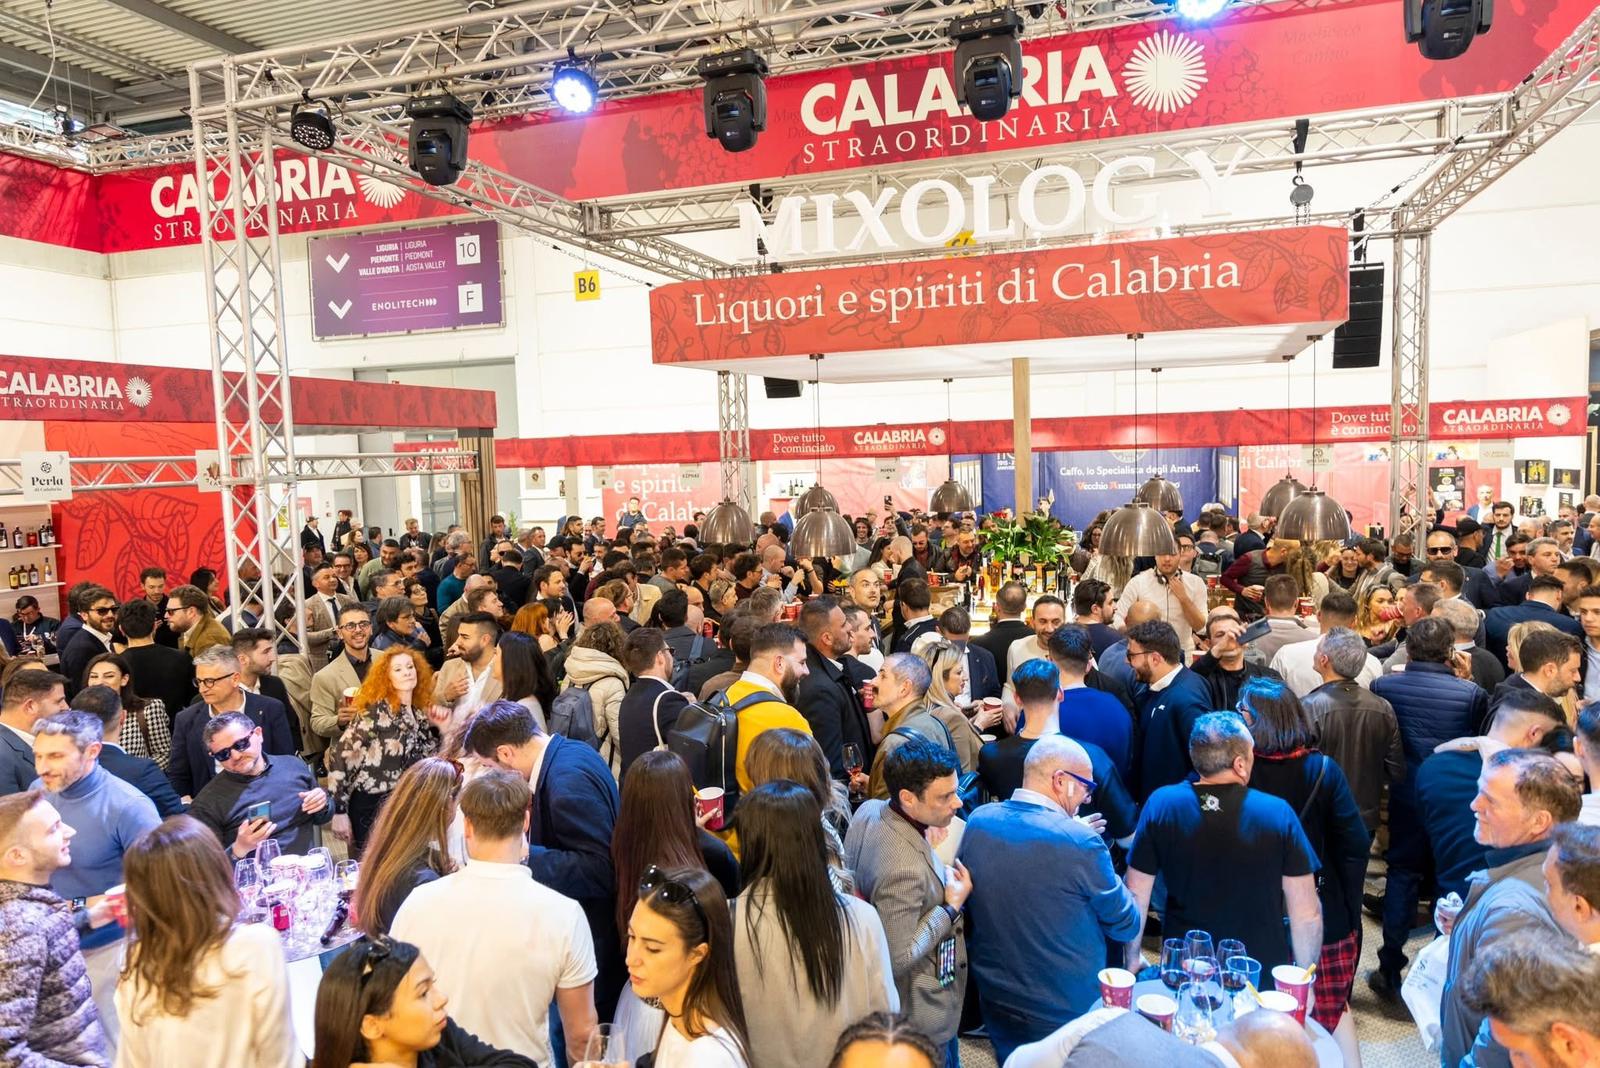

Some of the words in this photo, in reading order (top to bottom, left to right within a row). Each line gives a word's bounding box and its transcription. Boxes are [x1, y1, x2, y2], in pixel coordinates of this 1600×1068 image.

[800, 45, 1119, 136] CALARIA
[803, 106, 1120, 164] STRAORDINARIA
[736, 148, 1249, 263] MIXOLOGY
[154, 201, 358, 241] STRODNARIA
[376, 243, 399, 253] LIGURIA
[404, 240, 427, 250] LIGURIA
[460, 242, 477, 258] 10
[370, 254, 399, 264] PIEMONTE
[405, 250, 433, 261] PIEDMONT
[359, 267, 376, 276] VALLE
[376, 265, 400, 275] D'AOSTA
[405, 263, 424, 272] AOSTA
[424, 261, 446, 271] VALLEY
[578, 276, 596, 294] B6
[466, 290, 474, 307] F
[692, 284, 825, 335] Liquori
[838, 291, 858, 315] e
[869, 270, 986, 324] spiriti
[997, 267, 1039, 305] di
[1051, 253, 1241, 301] Calabria
[3, 397, 124, 411] TRAORDINARIA
[1331, 411, 1367, 424] Dove
[1371, 411, 1392, 422] tut
[1443, 406, 1543, 425] CALABRIA
[1331, 424, 1339, 437] è
[1342, 424, 1416, 437] comincto
[1442, 422, 1544, 433] STRAORDINARIA
[773, 433, 799, 444] Dove
[801, 433, 825, 443] tutto
[854, 429, 926, 446] CALABRIA
[781, 443, 836, 454] cominciato
[854, 442, 927, 452] STRAORDINARIA
[1060, 466, 1085, 477] Caffo,
[1097, 465, 1144, 477] Specialista
[1146, 463, 1169, 476] degli
[1170, 463, 1201, 474] Amari.
[1255, 455, 1300, 470] Calabr
[31, 475, 64, 487] Perla
[614, 478, 625, 494] e
[631, 474, 692, 499] spiri
[1075, 481, 1109, 492] Vecchio
[642, 501, 713, 522] Calabr
